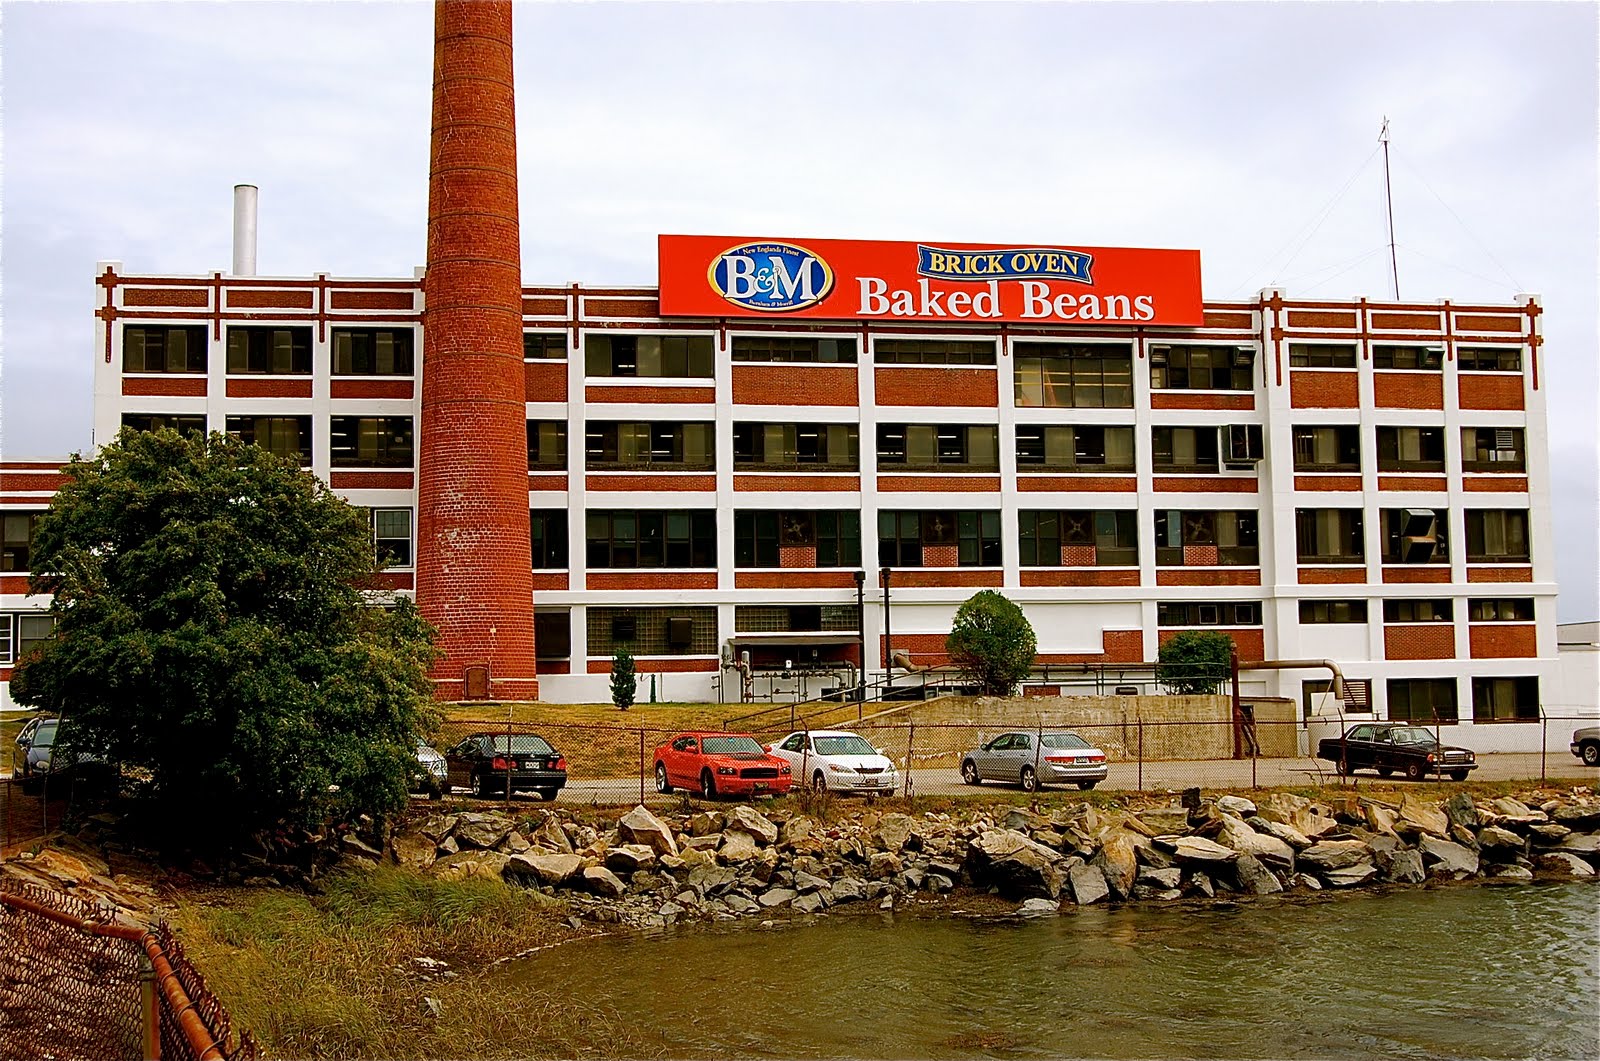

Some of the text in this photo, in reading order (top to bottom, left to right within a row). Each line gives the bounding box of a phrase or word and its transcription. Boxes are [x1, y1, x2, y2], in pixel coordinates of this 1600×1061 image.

[722, 255, 817, 300] B&M
[929, 252, 1080, 275] BRICK OVEN
[855, 276, 1155, 321] Baked Beans
